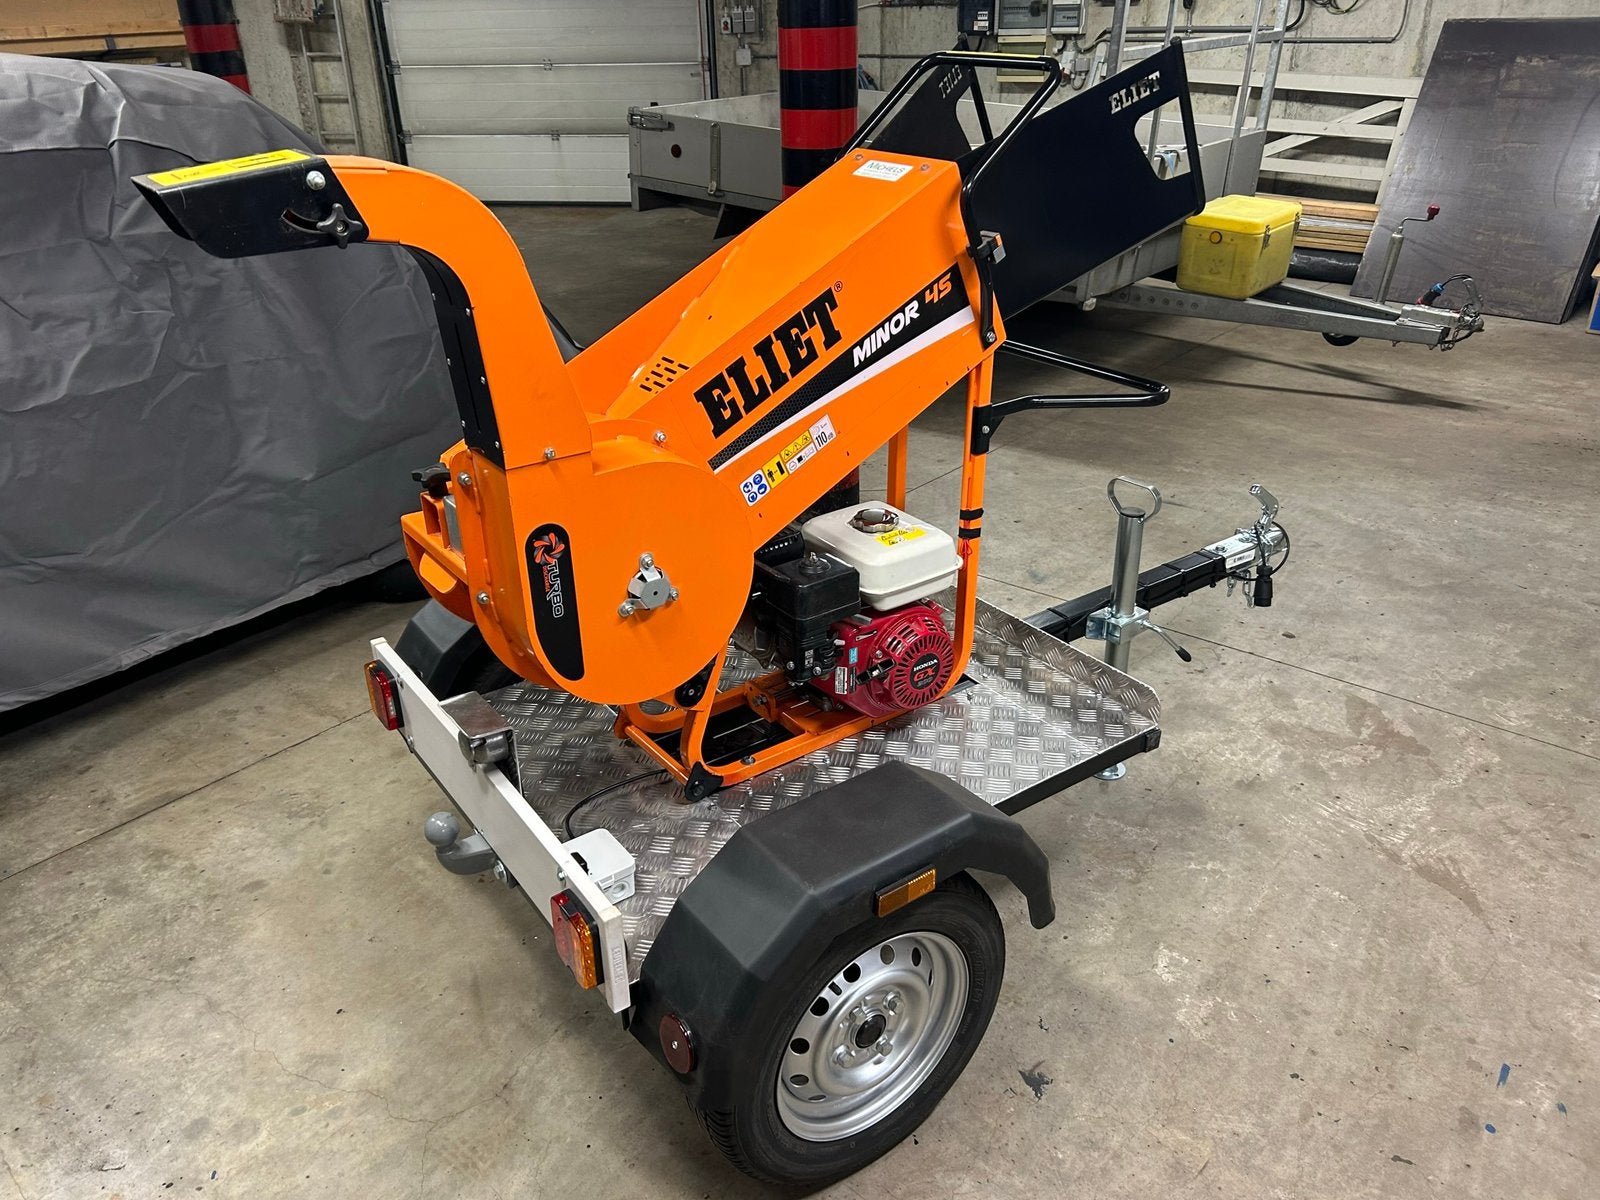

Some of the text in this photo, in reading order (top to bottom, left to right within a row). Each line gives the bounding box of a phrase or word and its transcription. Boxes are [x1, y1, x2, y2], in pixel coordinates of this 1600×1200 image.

[1108, 70, 1161, 115] ELIET
[852, 272, 953, 368] MINOR 45
[693, 286, 843, 440] ELIET
[815, 431, 828, 448] 110
[546, 559, 565, 619] TURBO
[913, 659, 939, 672] HONDA
[913, 665, 937, 682] GX
